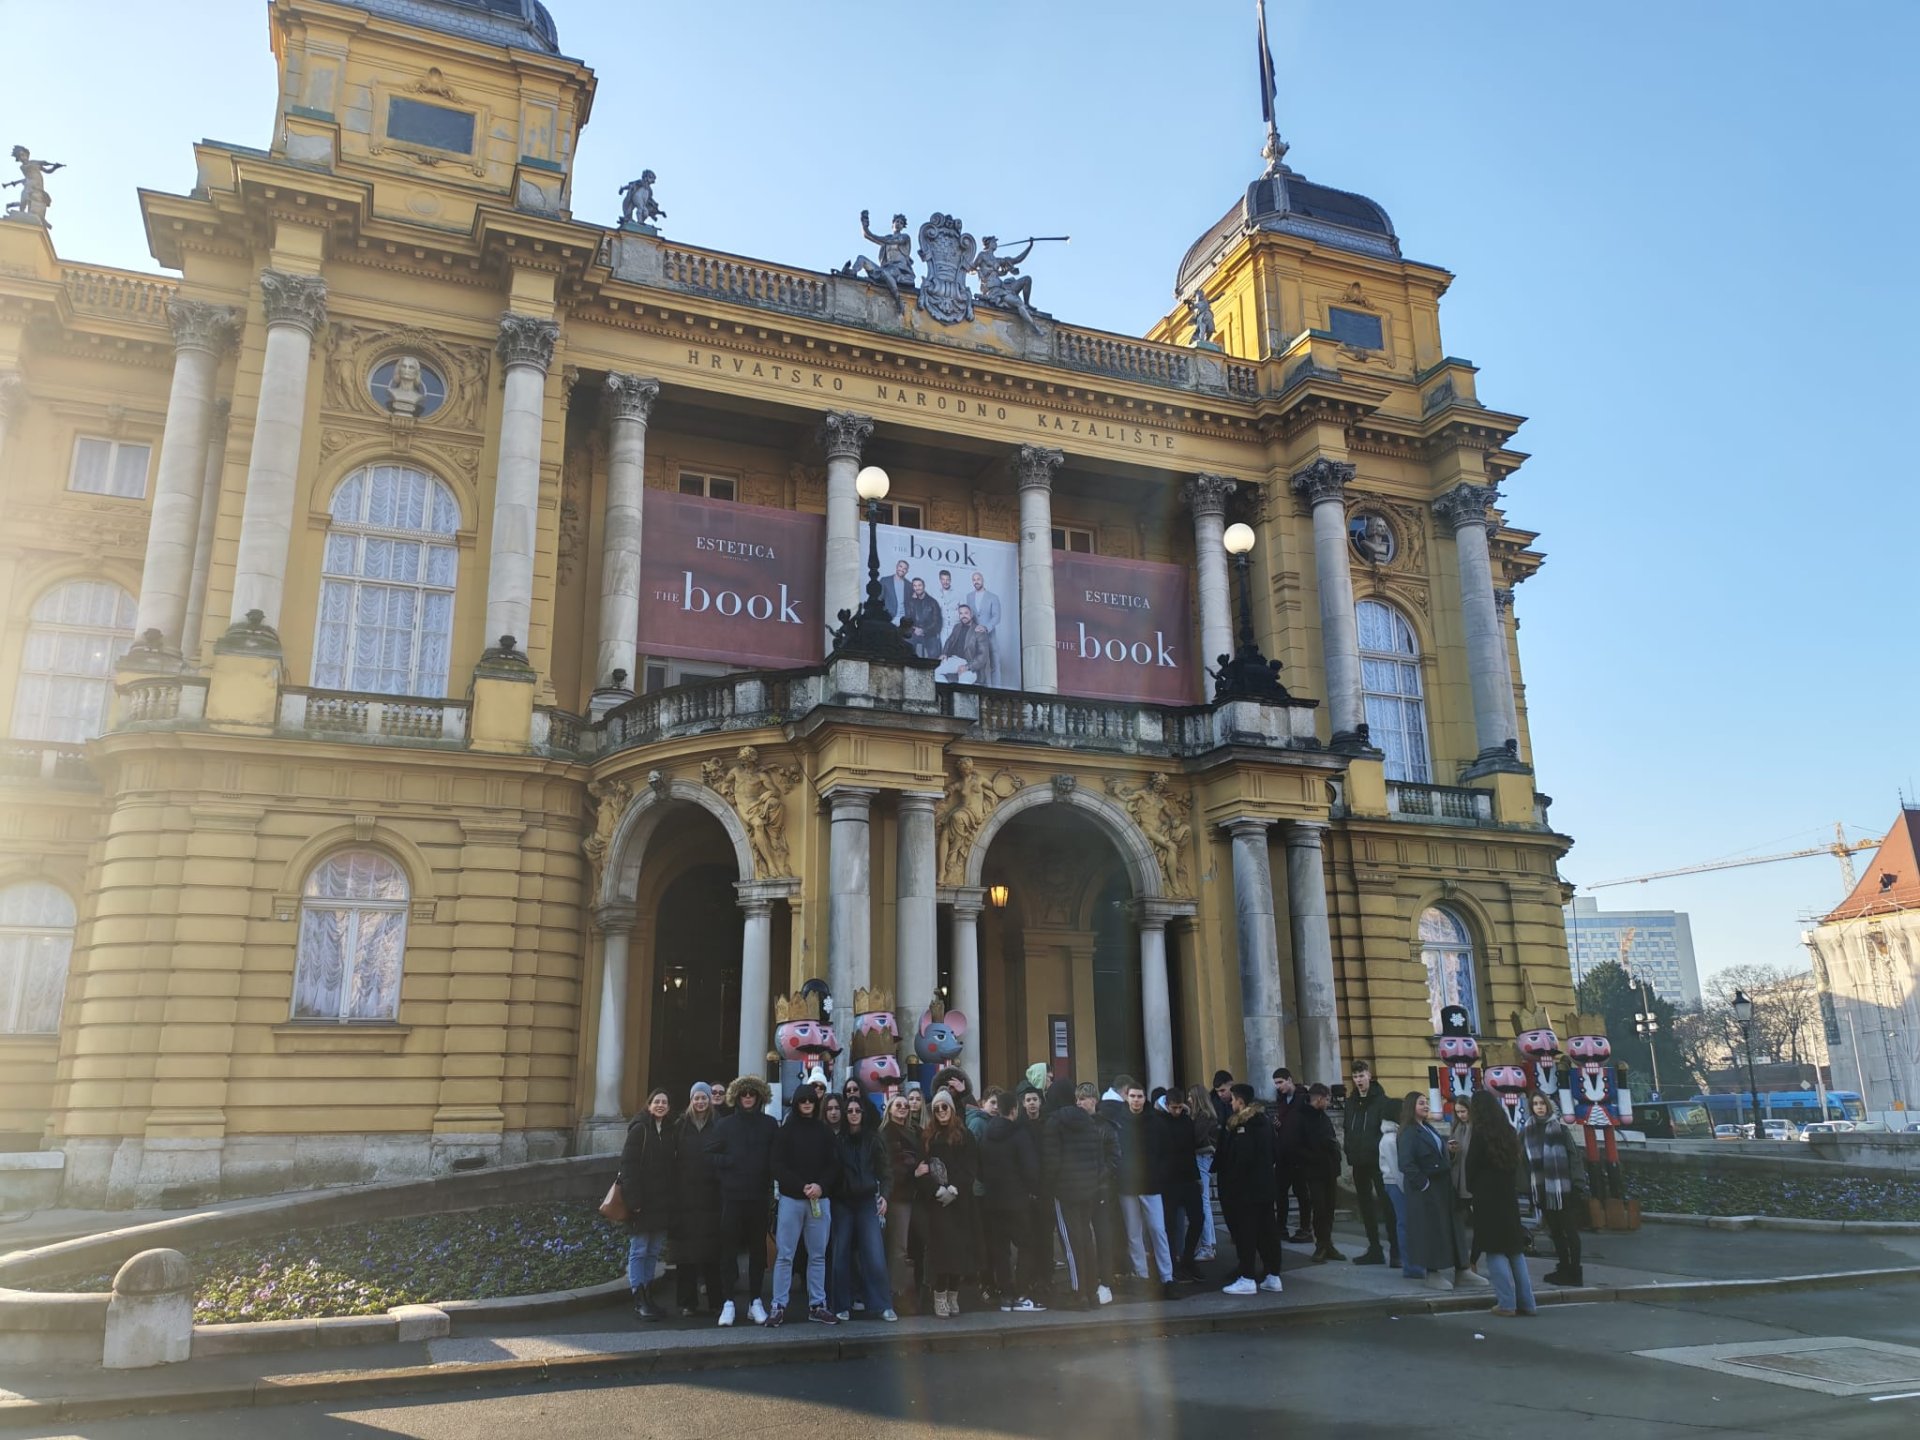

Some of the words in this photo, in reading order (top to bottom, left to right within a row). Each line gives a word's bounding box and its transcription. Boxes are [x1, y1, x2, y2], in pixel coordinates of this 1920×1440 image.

[687, 349, 843, 391] HRVATSKO
[877, 384, 1007, 421] NARODNO
[1037, 413, 1175, 449] KAZALIŠTE
[696, 536, 775, 559] ESTETICA
[909, 534, 978, 567] book
[654, 590, 680, 603] THE
[681, 570, 804, 625] book
[1085, 590, 1151, 609] ESTETICA
[1056, 640, 1077, 651] THE
[1076, 621, 1178, 668] book
